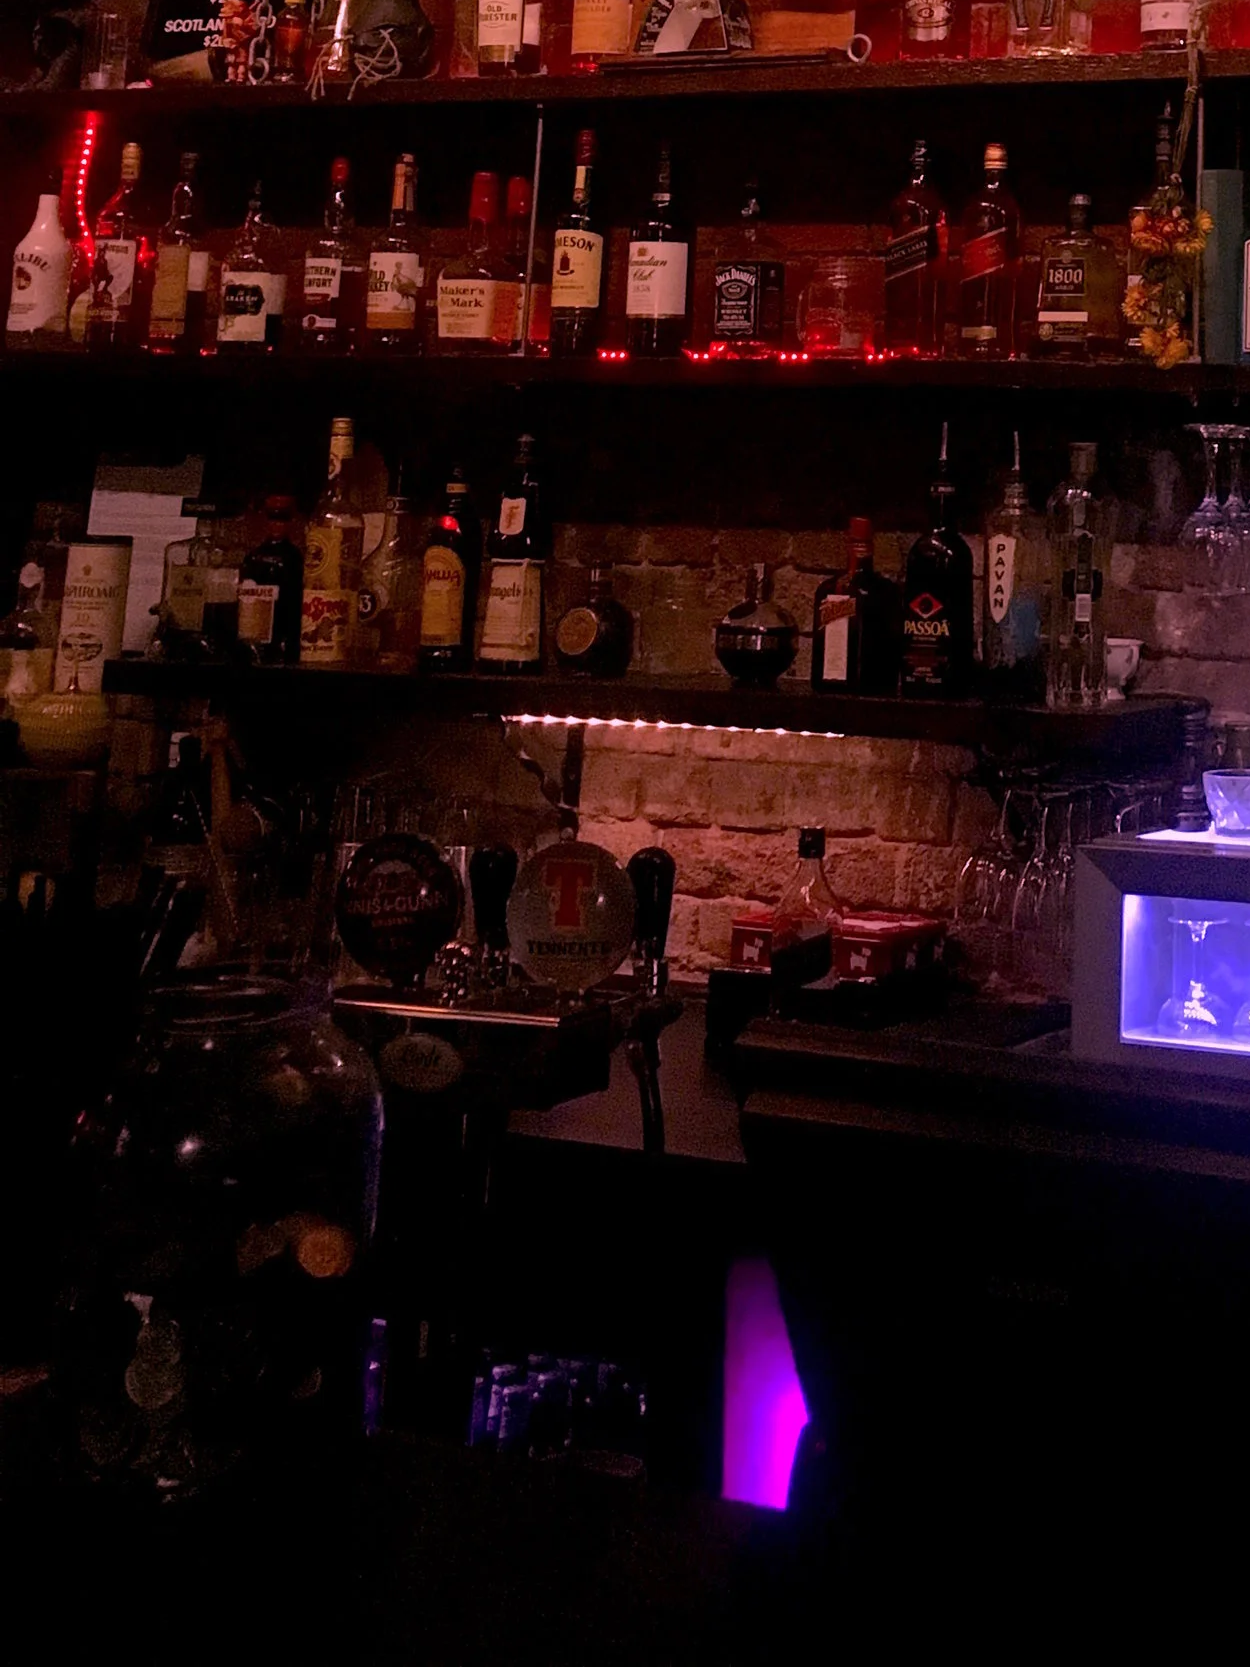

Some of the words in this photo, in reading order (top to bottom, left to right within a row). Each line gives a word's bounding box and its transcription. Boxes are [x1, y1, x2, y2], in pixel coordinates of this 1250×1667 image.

[487, 5, 502, 13] OLD
[164, 18, 226, 32] SCOTLAN
[556, 236, 596, 252] MESON
[715, 271, 731, 286] JACK
[730, 266, 756, 286] DANIEL'S
[1048, 267, 1083, 285] 1800
[440, 286, 485, 295] Maker's
[450, 298, 484, 308] Mark
[993, 543, 1006, 608] PAVAN
